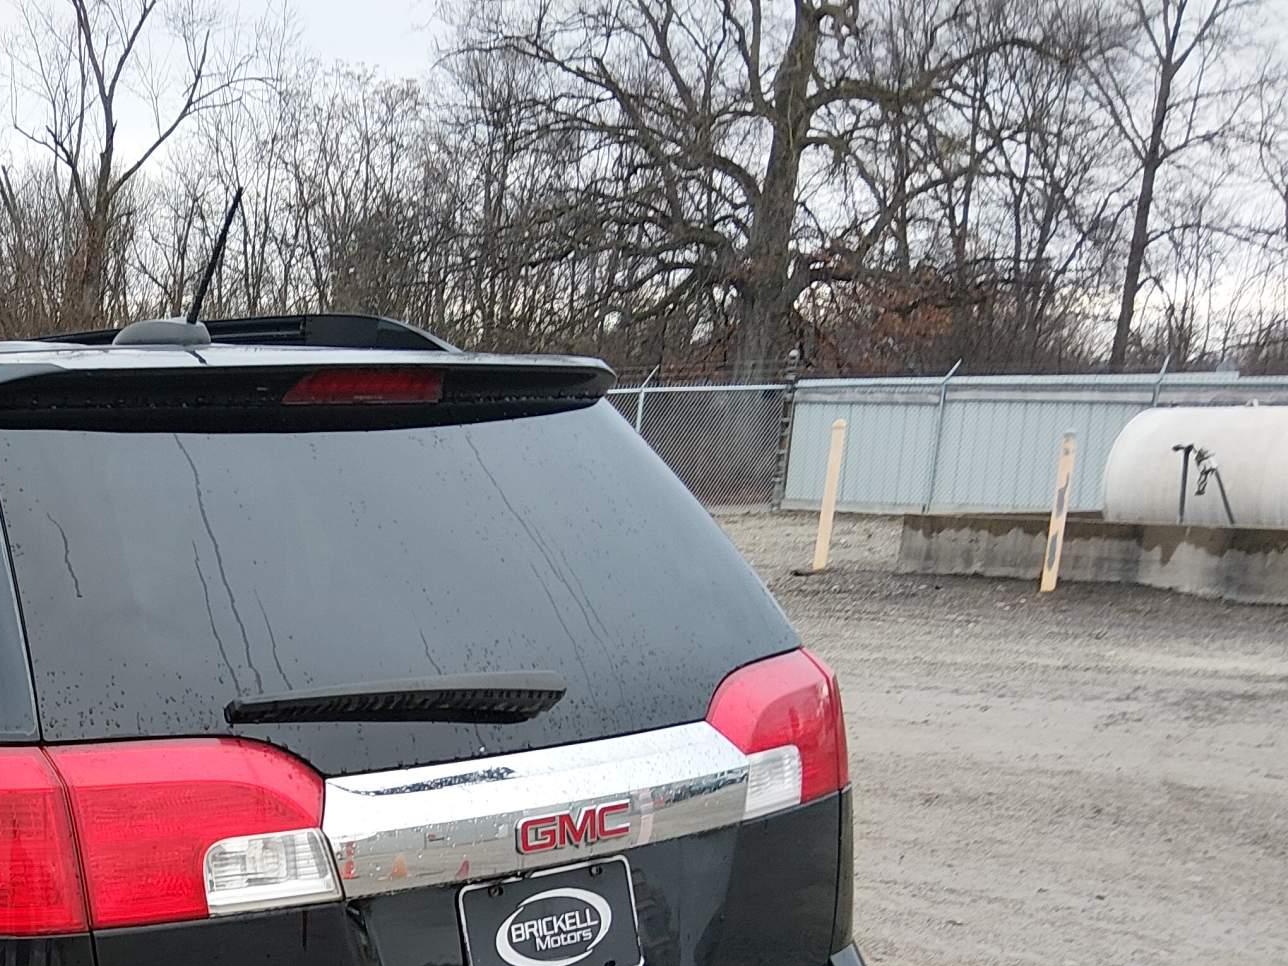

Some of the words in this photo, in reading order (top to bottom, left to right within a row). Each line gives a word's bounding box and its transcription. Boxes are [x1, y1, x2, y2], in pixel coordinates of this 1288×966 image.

[516, 799, 630, 854] GMC
[511, 909, 599, 942] BRICKELL
[536, 928, 592, 951] Motors
